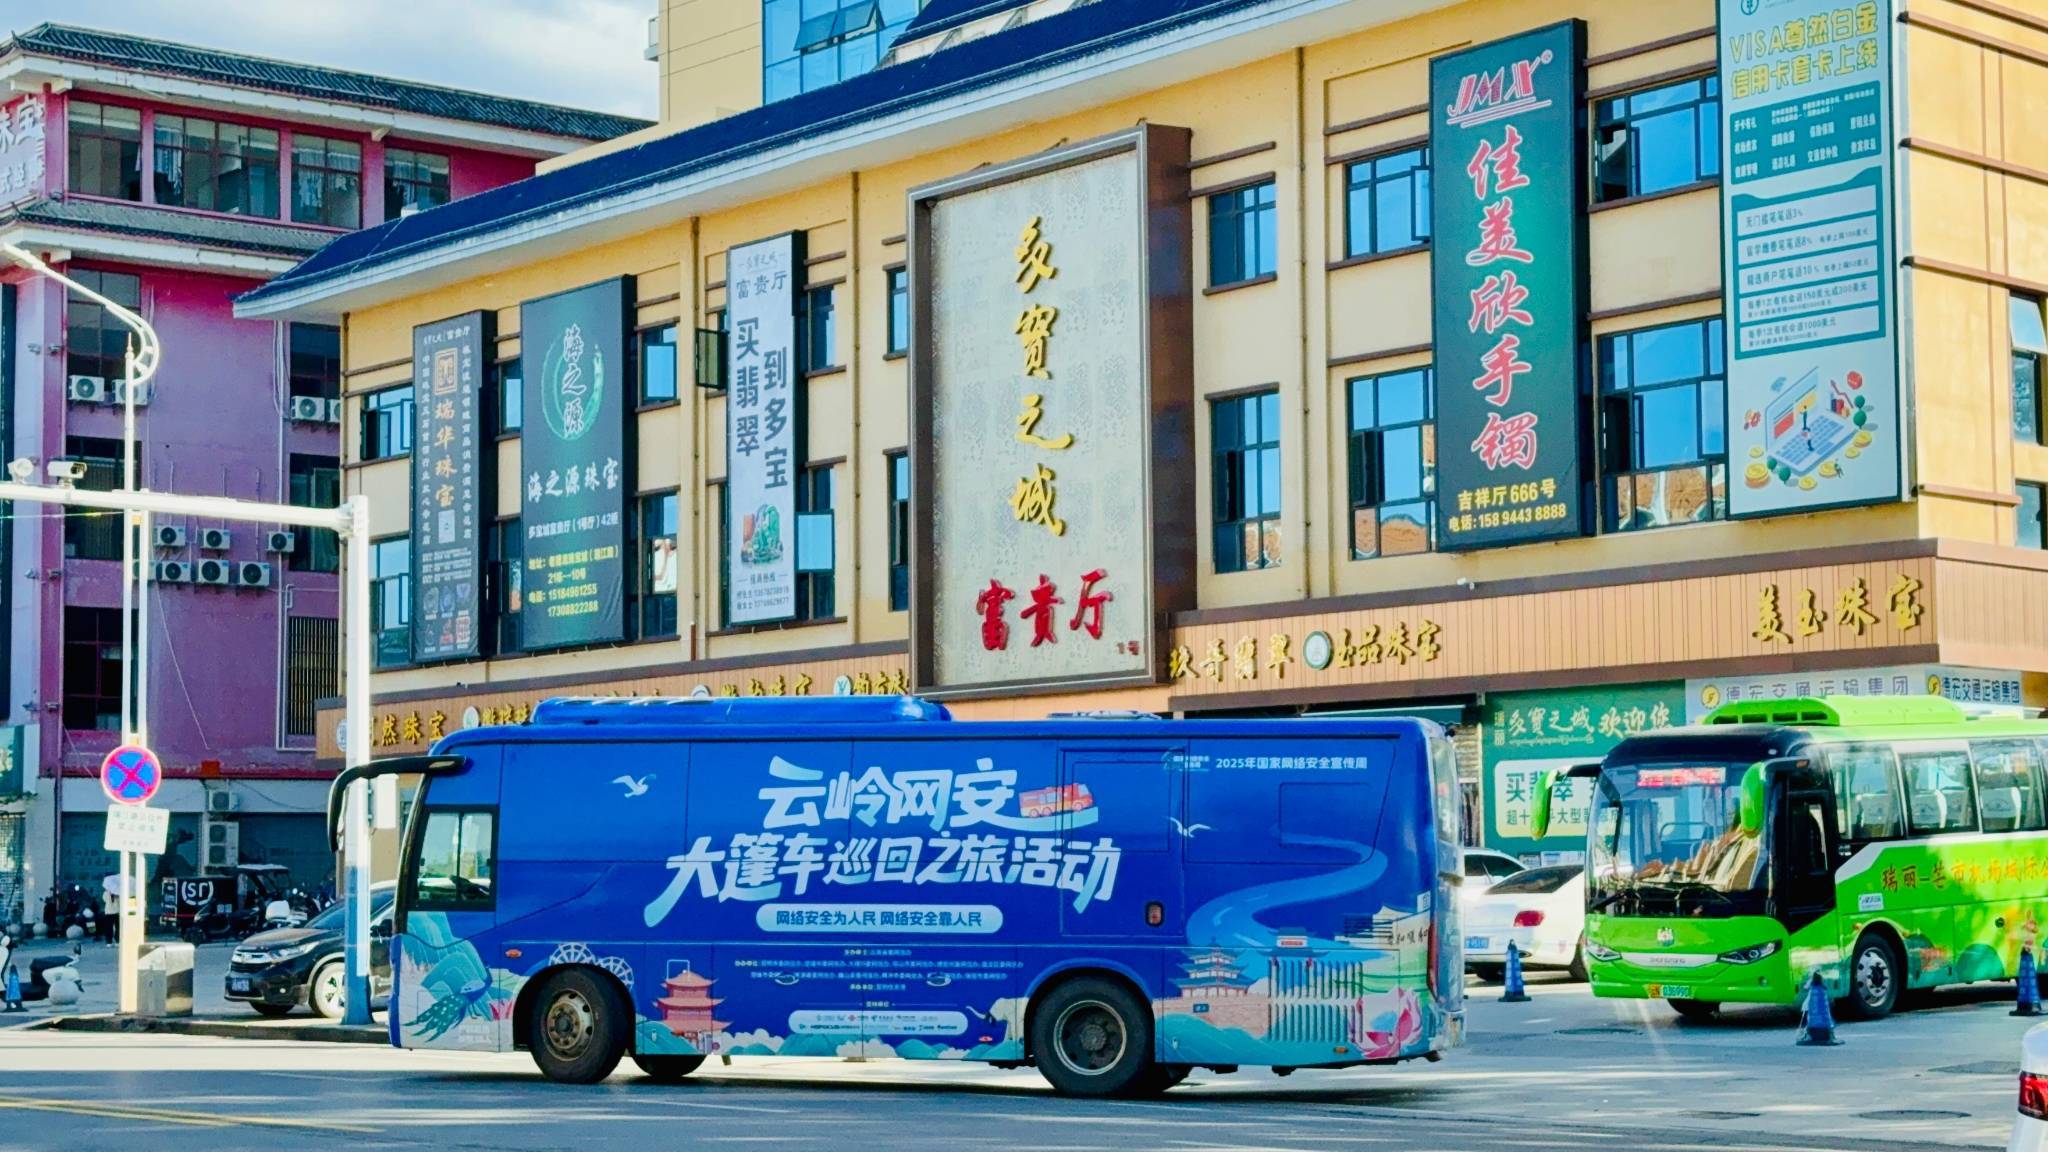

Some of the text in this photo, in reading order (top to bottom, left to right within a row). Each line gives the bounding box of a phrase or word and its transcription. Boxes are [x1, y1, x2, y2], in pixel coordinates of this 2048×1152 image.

[736, 270, 787, 299] 富贵厅
[1466, 125, 1538, 471] 佳美欣手镯
[736, 316, 759, 457] 买翡翠
[764, 346, 788, 489] 到多宝
[528, 457, 619, 502] 海之源珠宝
[1458, 477, 1556, 512] 吉祥厅666号
[1501, 507, 1532, 525] 9443
[1535, 503, 1567, 521] 8888
[1753, 575, 1924, 644] 美玉珠宝
[370, 709, 447, 747] 然珠宝
[1216, 756, 1368, 770] 2025年国家网络安全宣传周
[757, 756, 1090, 832] 云岭网安
[644, 831, 1122, 928] 大篷车巡回之旅活动
[776, 910, 983, 928] 网络安全为人民 网络安全靠人民
